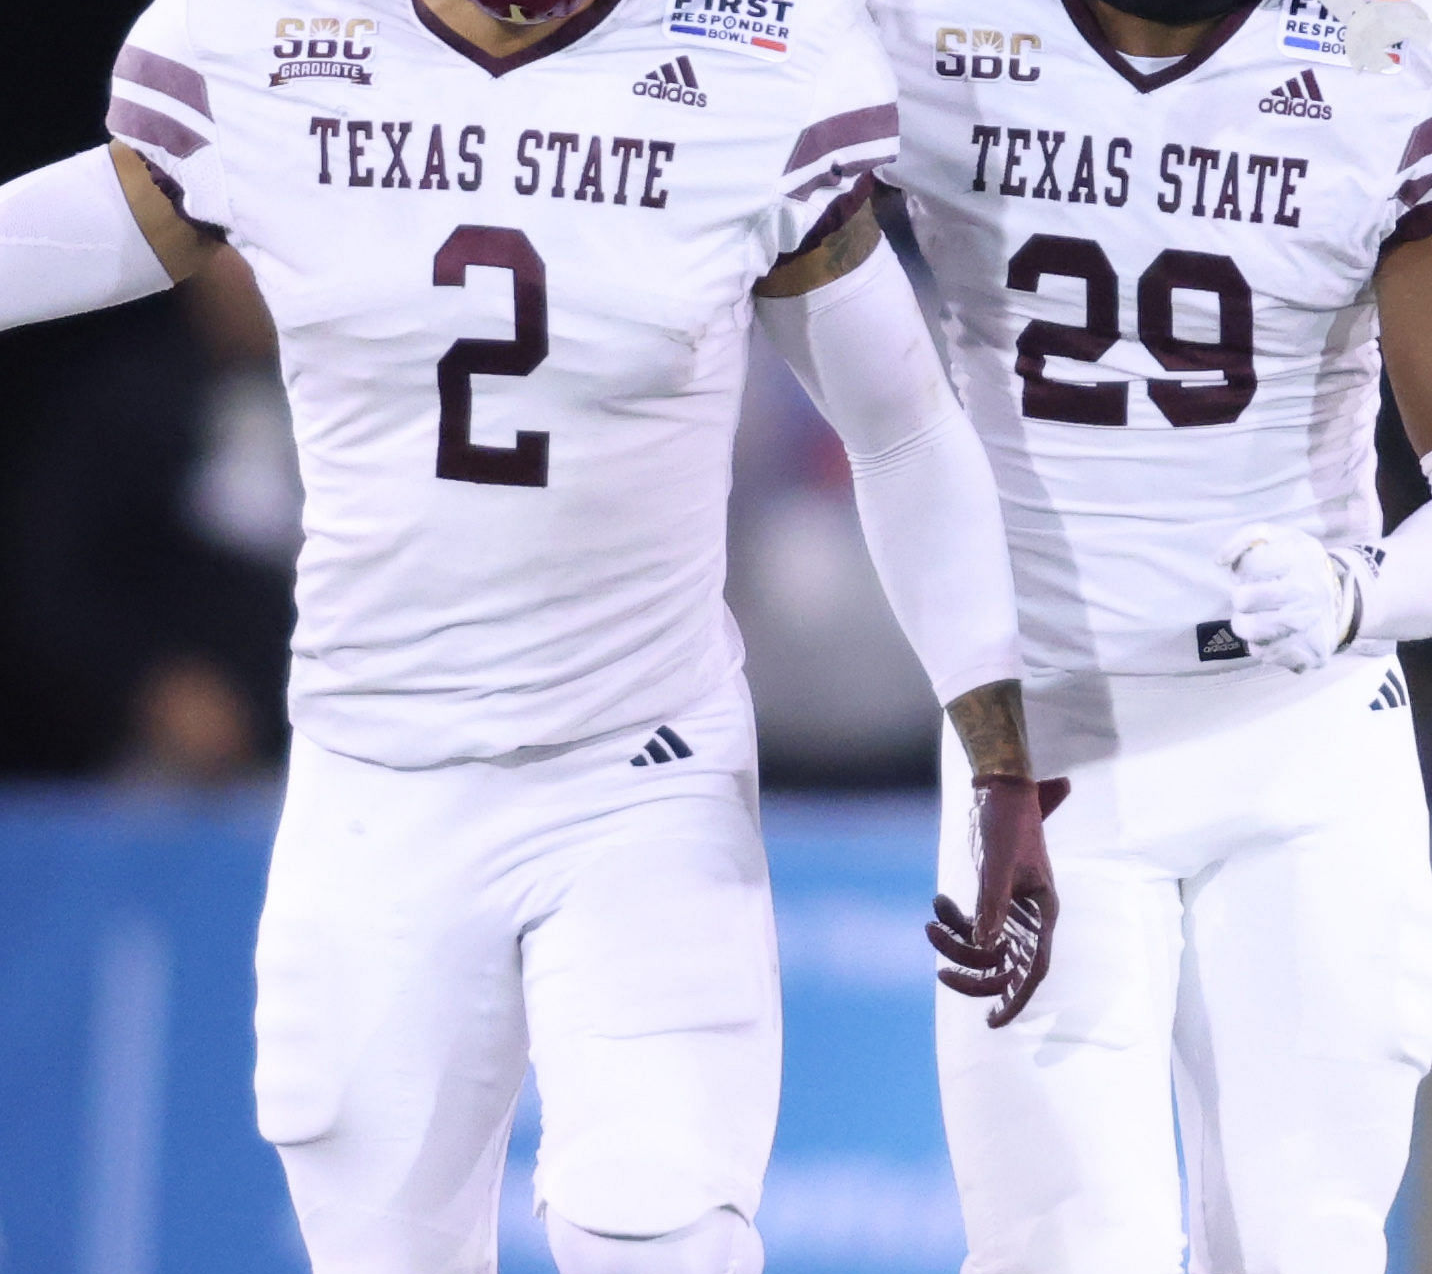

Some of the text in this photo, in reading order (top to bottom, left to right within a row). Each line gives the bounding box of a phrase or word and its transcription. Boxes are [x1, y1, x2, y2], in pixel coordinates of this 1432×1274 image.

[273, 18, 375, 60] SBC
[670, 12, 790, 39] RESPONDER
[708, 29, 748, 44] BOWL
[280, 62, 361, 78] GRADUATE
[936, 28, 1042, 82] SBC
[632, 80, 708, 108] adidas
[1258, 96, 1333, 121] adidas
[309, 117, 675, 209] TEXAS STATE
[972, 124, 1310, 228] TEXAS STATE
[1006, 232, 1259, 428] 29
[432, 223, 550, 488] 2
[1203, 641, 1241, 654] adidas
